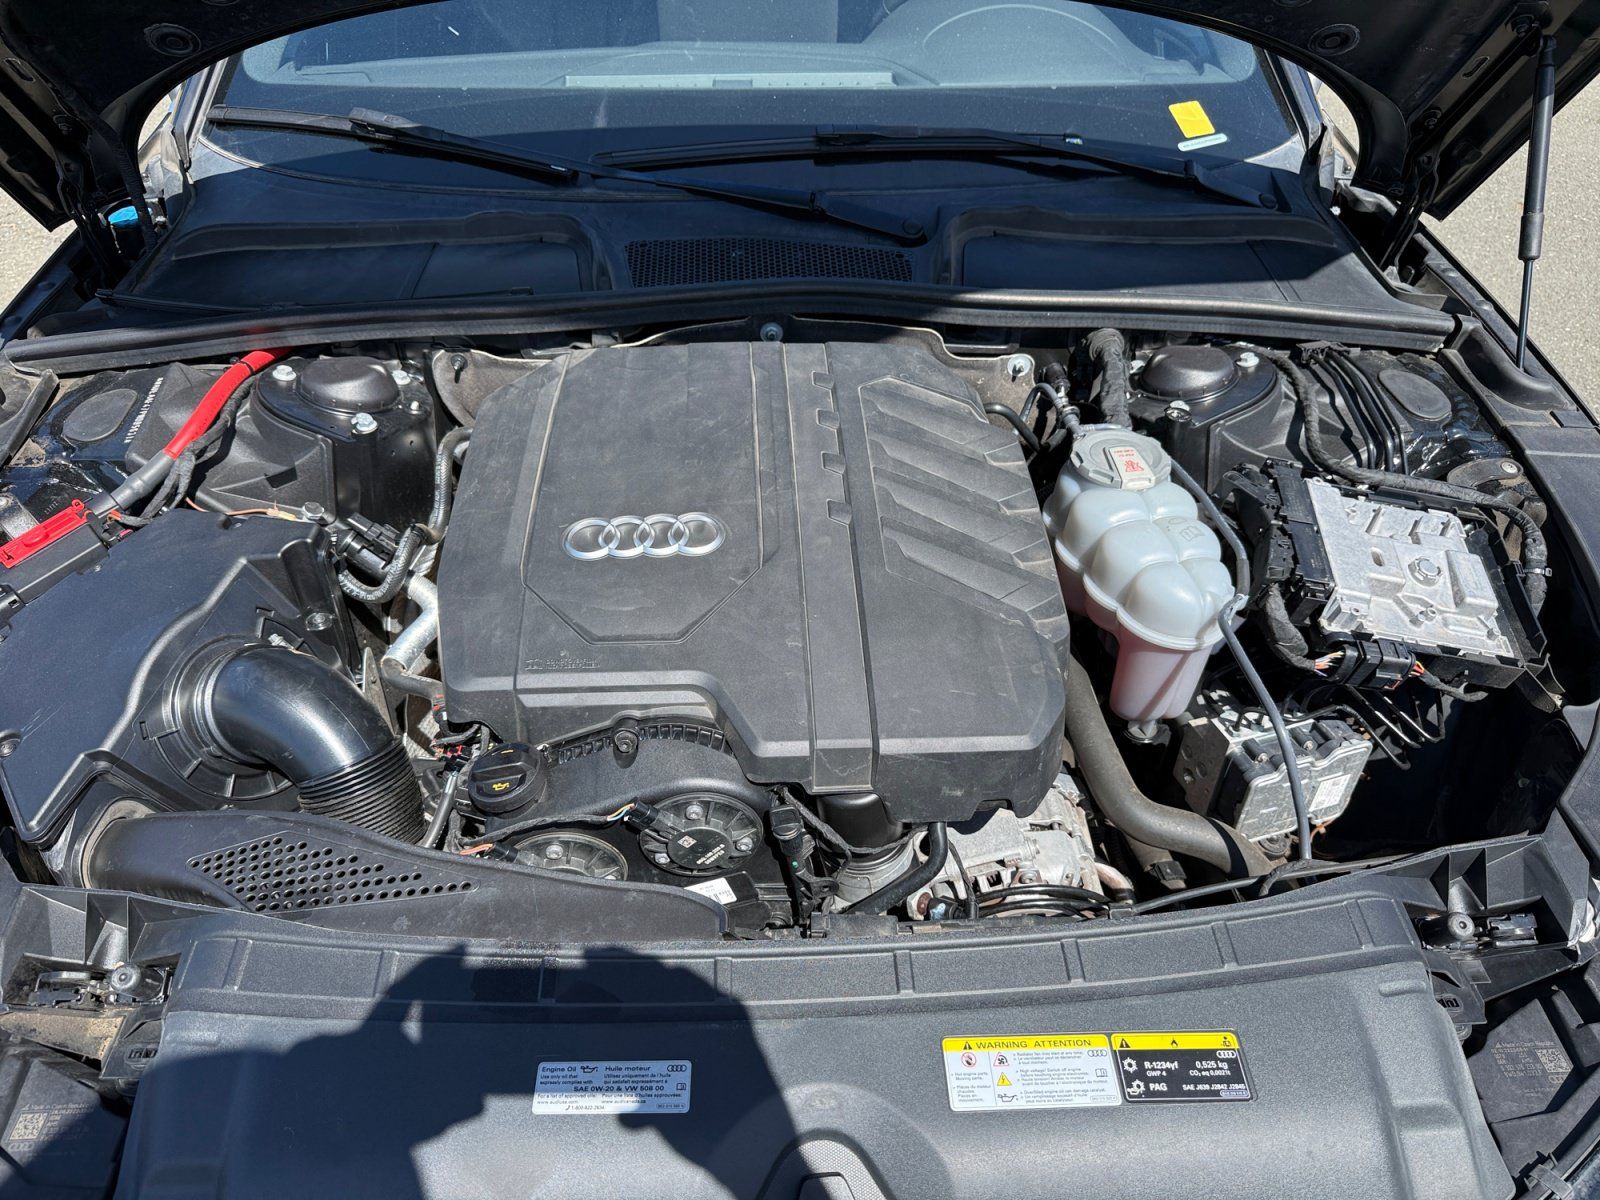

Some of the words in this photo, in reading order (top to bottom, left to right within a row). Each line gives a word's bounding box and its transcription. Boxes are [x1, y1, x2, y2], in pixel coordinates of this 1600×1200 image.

[976, 1041, 1028, 1049] WARNING
[1144, 1061, 1179, 1071] R-1234yf
[1218, 1061, 1228, 1070] kg
[1149, 1083, 1168, 1091] PAG
